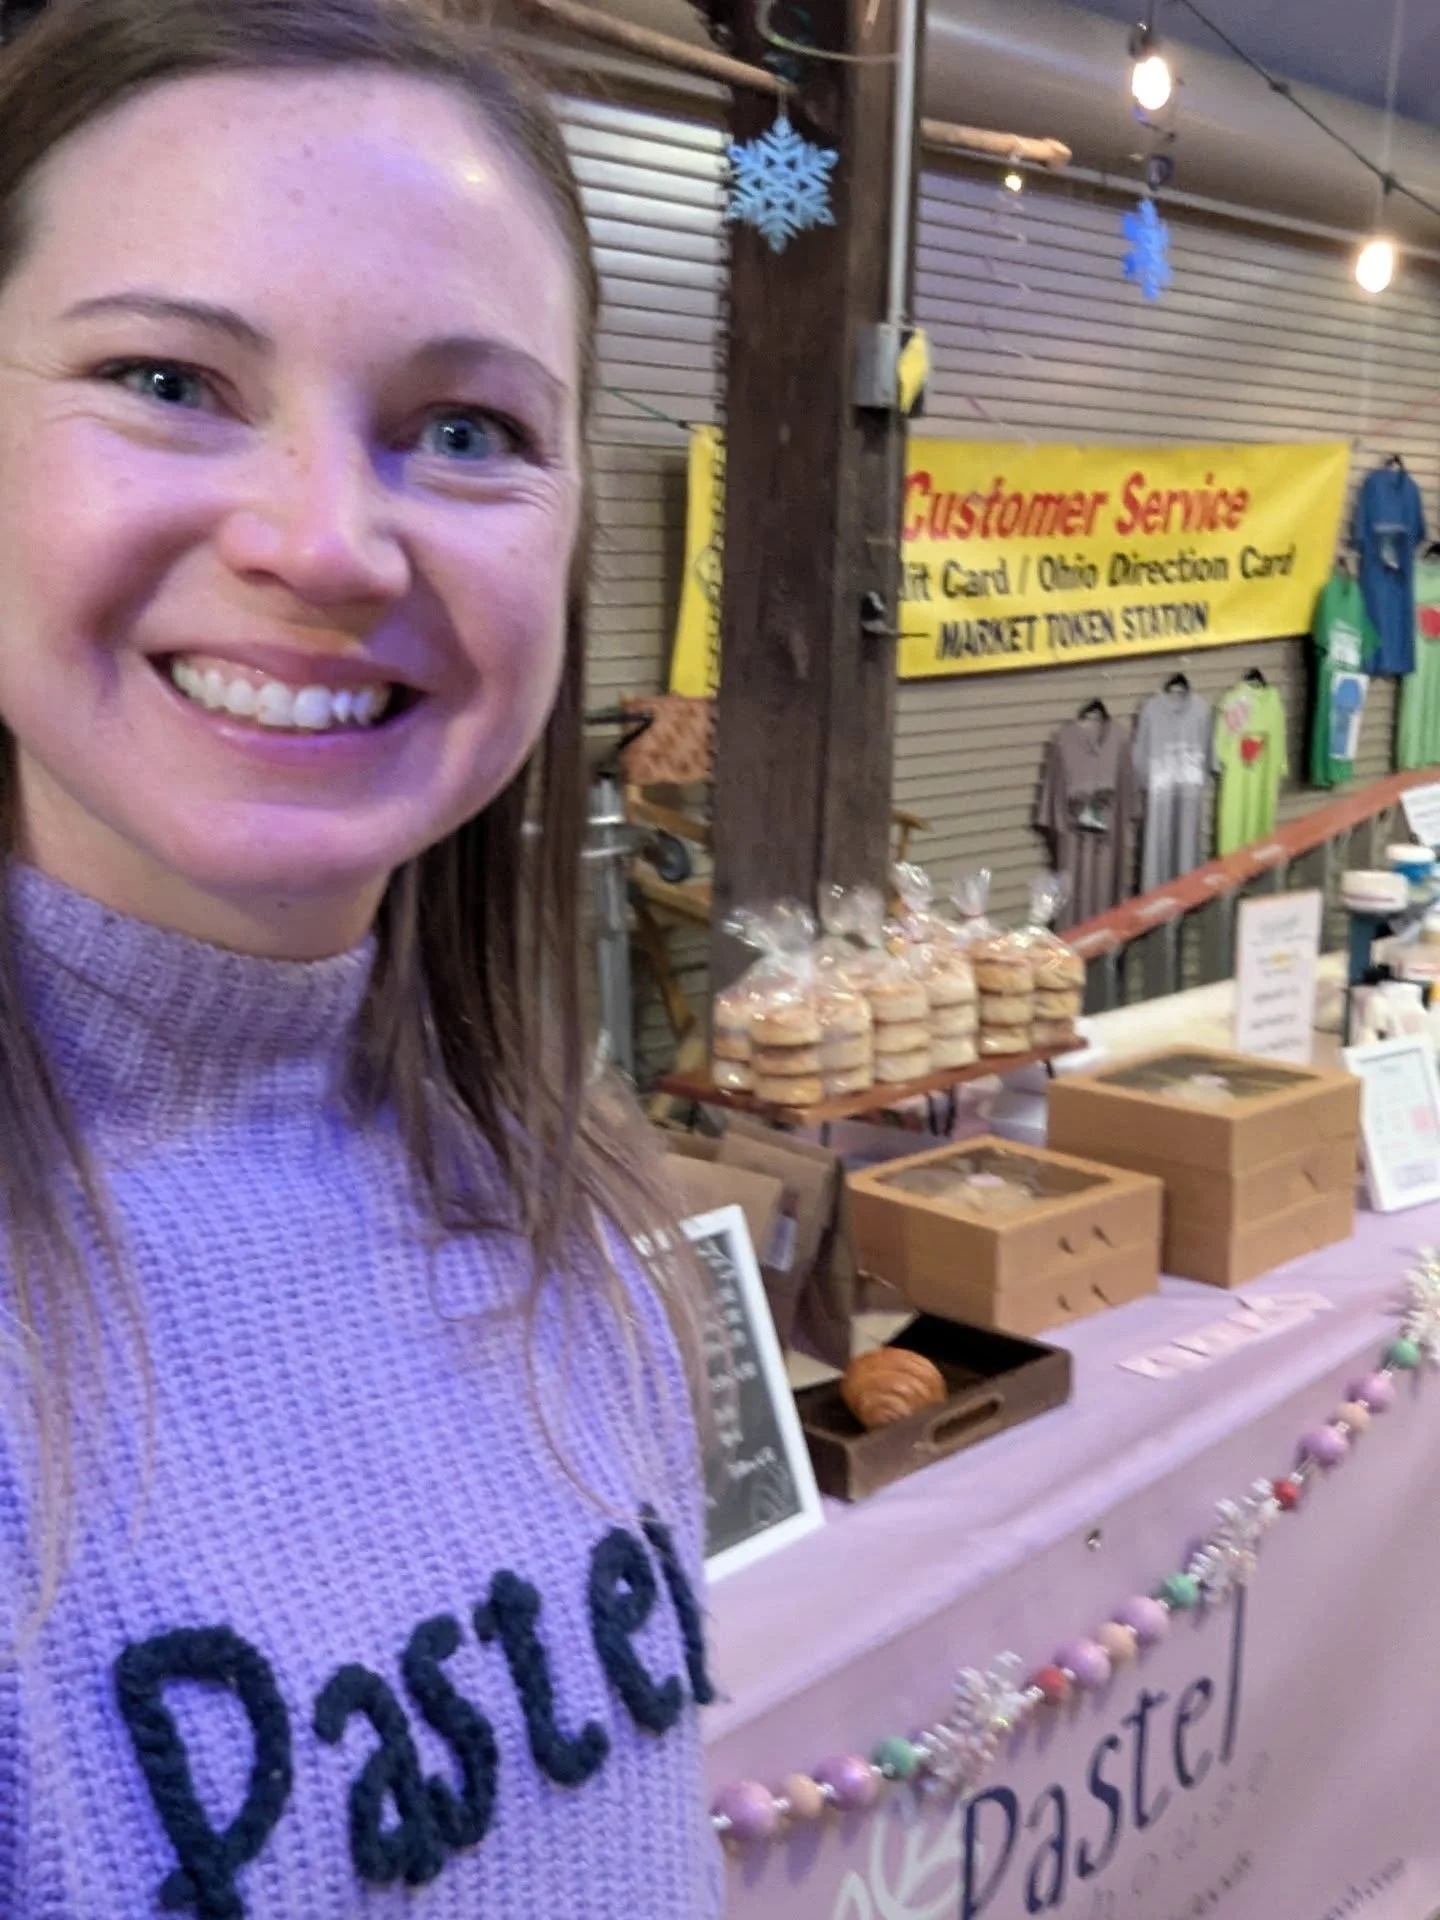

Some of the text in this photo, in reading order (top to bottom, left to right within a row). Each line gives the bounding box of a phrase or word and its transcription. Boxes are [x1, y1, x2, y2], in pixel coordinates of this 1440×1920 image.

[901, 470, 1250, 542] Customer Service
[942, 556, 1009, 599] Card
[1038, 553, 1099, 593] Ohio
[1108, 545, 1229, 588] Direction
[1239, 544, 1296, 580] Card
[935, 600, 1210, 661] MARKET TOKEN STATION
[114, 1502, 714, 1920] Pastel
[961, 1582, 1246, 1920] Pastel
